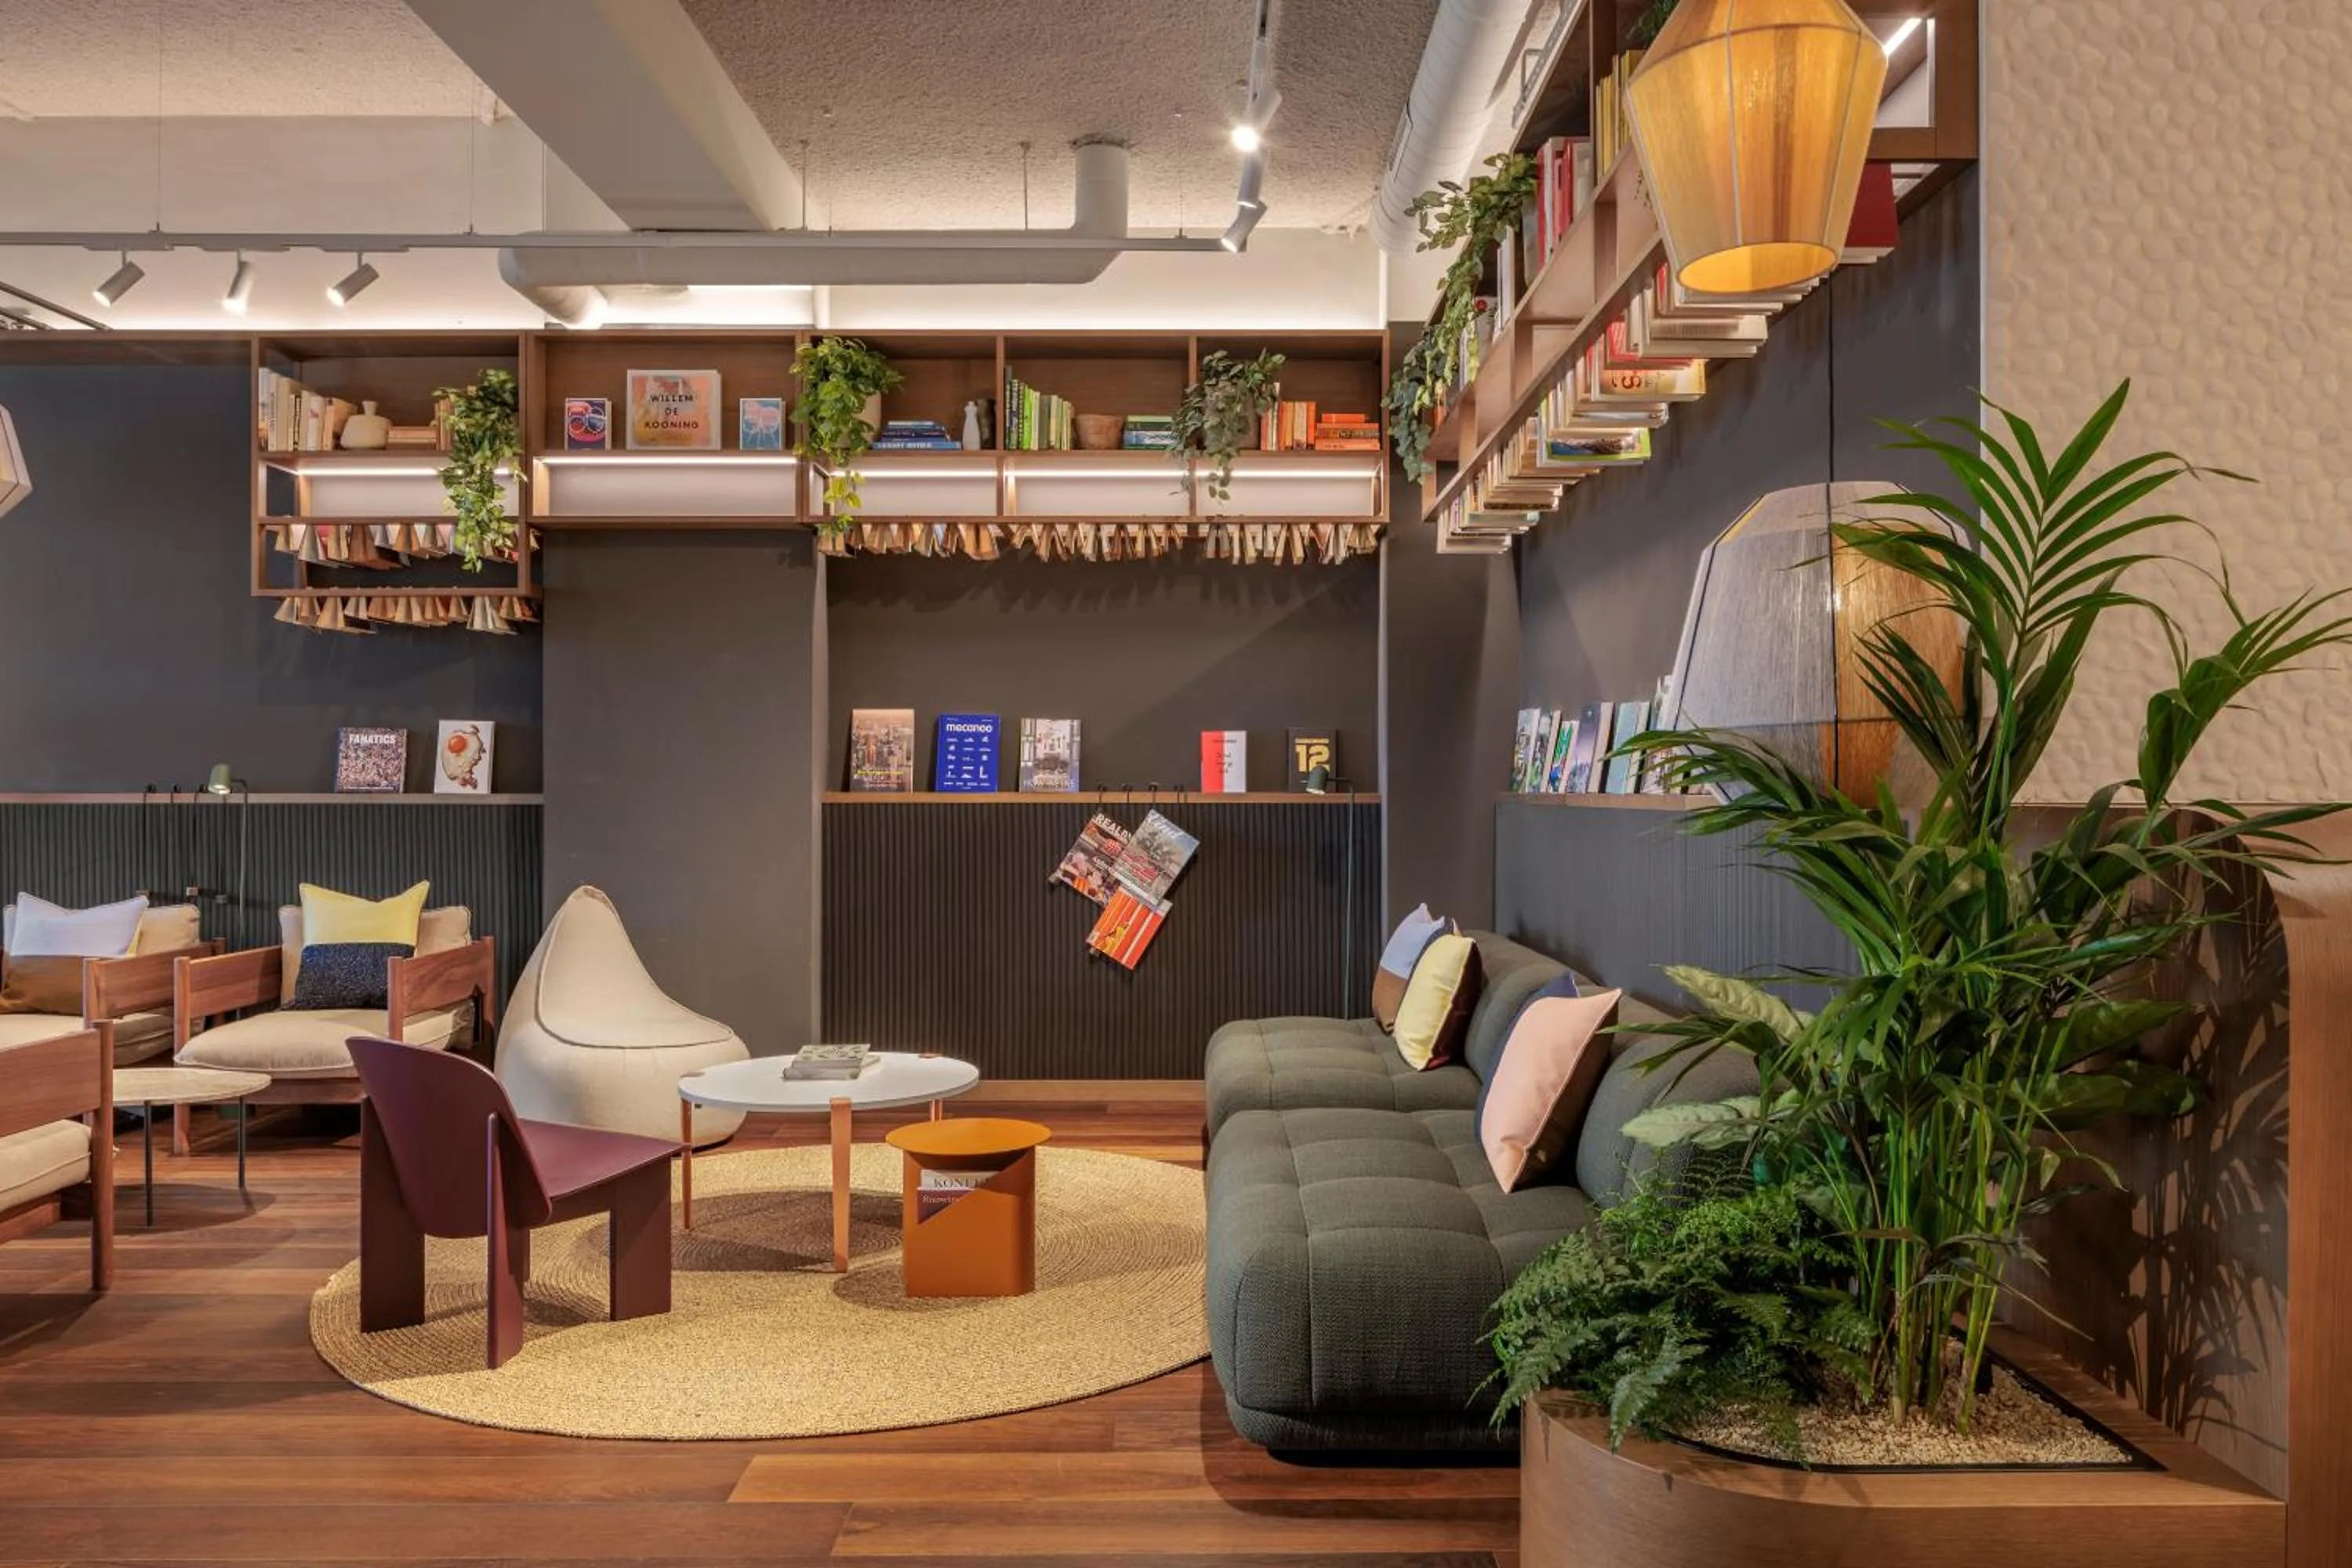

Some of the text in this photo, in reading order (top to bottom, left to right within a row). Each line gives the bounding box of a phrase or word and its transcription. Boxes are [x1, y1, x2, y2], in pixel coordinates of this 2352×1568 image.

[665, 406, 678, 416] DE
[644, 421, 699, 430] KOONING
[349, 733, 396, 744] FANATICS
[1295, 744, 1330, 773] 12
